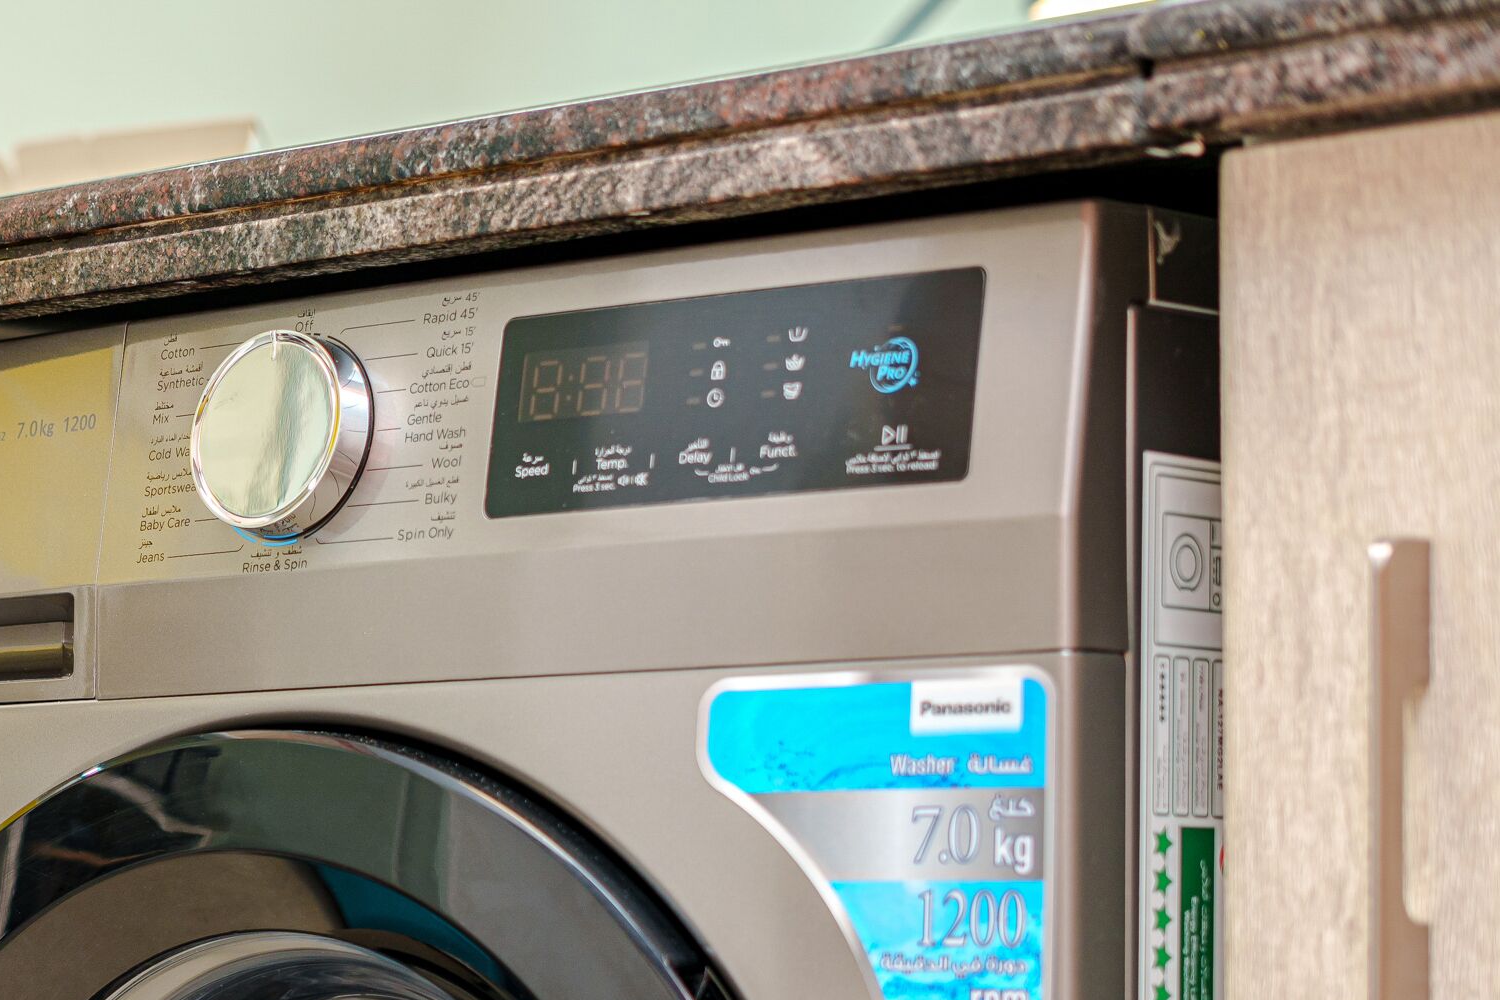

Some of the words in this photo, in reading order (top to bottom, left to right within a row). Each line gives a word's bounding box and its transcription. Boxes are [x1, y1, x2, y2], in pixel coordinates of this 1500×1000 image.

[423, 309, 457, 324] Rapid
[460, 307, 478, 319] 45'
[295, 320, 313, 332] Off
[161, 347, 195, 360] Cotton
[427, 345, 457, 358] Quick
[461, 342, 474, 354] 15'
[849, 350, 910, 368] HYGIENE
[877, 365, 907, 381] PRO
[157, 376, 204, 392] Synthetic
[410, 381, 446, 394] Cotton
[449, 378, 469, 390] Eco
[63, 413, 97, 432] 1200
[152, 413, 169, 425] Mix
[407, 411, 442, 426] Gentle
[405, 430, 433, 443] Hand
[437, 427, 466, 439] Wash
[148, 448, 171, 461] Cold
[176, 446, 190, 458] Wa
[678, 451, 712, 465] Delay
[431, 456, 462, 469] Wool
[596, 458, 628, 470] Temp.
[515, 463, 550, 479] Speed
[707, 472, 728, 483] Child
[728, 472, 749, 482] Lock
[144, 483, 197, 498] Sportswea
[573, 484, 594, 493] Press
[425, 491, 457, 505] Bulky
[140, 519, 165, 531] Baby
[168, 517, 190, 528] Care
[397, 528, 424, 542] Spin
[428, 526, 454, 540] Only
[136, 553, 165, 564] Jeans
[242, 562, 271, 573] Rinse
[273, 559, 281, 571] &
[284, 559, 308, 571] Spin
[920, 699, 1011, 716] Panasonic
[890, 754, 955, 777] Washer
[967, 752, 1034, 775] غسالة
[911, 804, 980, 866] 7.0
[993, 828, 1035, 875] kg
[916, 888, 1026, 949] 1200
